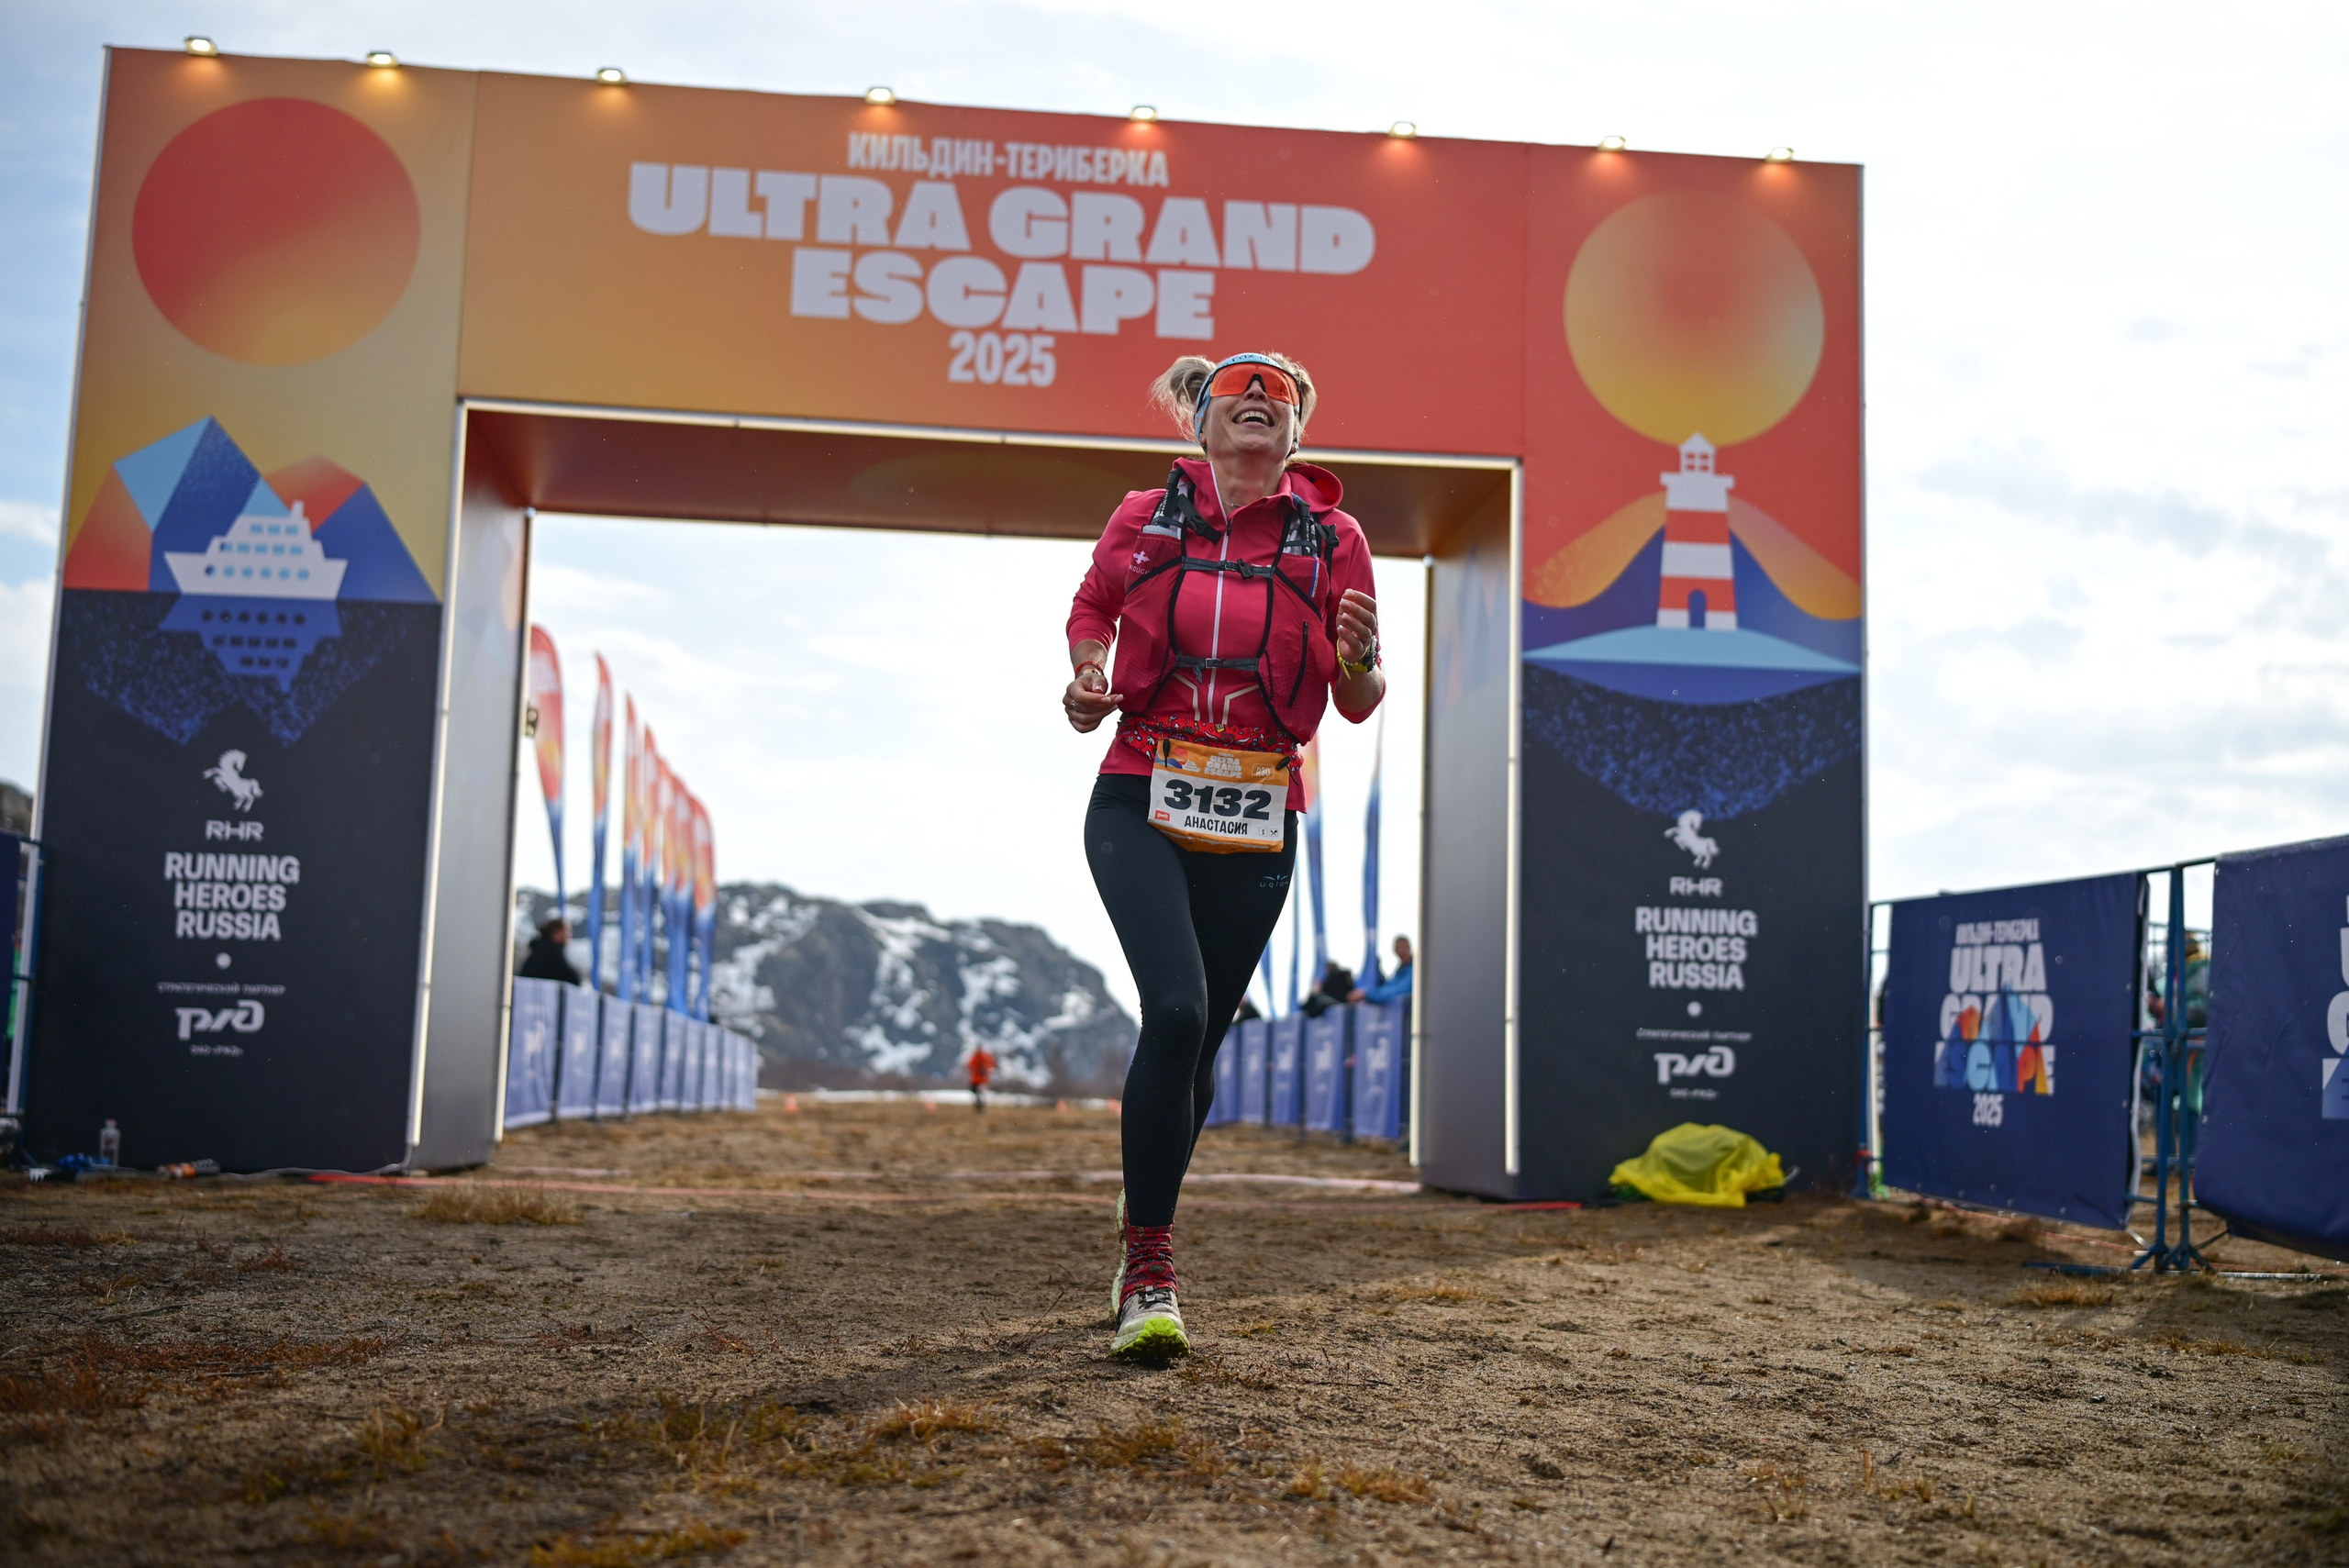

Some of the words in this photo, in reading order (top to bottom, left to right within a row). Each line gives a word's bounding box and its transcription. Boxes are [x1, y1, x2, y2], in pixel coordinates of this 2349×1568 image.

[847, 131, 1170, 187] КИЛЬДИН-ТЕРИБЕРКА
[628, 161, 971, 252] ULTRA
[988, 185, 1375, 275] GRAND
[790, 247, 1216, 340] ESCAPE
[947, 331, 1057, 388] 2025
[1204, 767, 1242, 779] ESCAPE
[1206, 761, 1242, 772] GRAND
[1209, 755, 1241, 765] ULTRA
[1163, 779, 1272, 821] 3132
[205, 819, 265, 842] RHR
[1184, 816, 1249, 835] АНАСТАСИЯ
[164, 851, 301, 885] RUNNING
[173, 880, 287, 912] HEROES
[1669, 876, 1724, 897] RHR
[175, 909, 282, 941] RUSSIA
[1635, 906, 1758, 937] RUNNING
[1645, 933, 1747, 963] HEROES
[1649, 961, 1744, 991] RUSSIA
[1949, 942, 2047, 994] ULTRA
